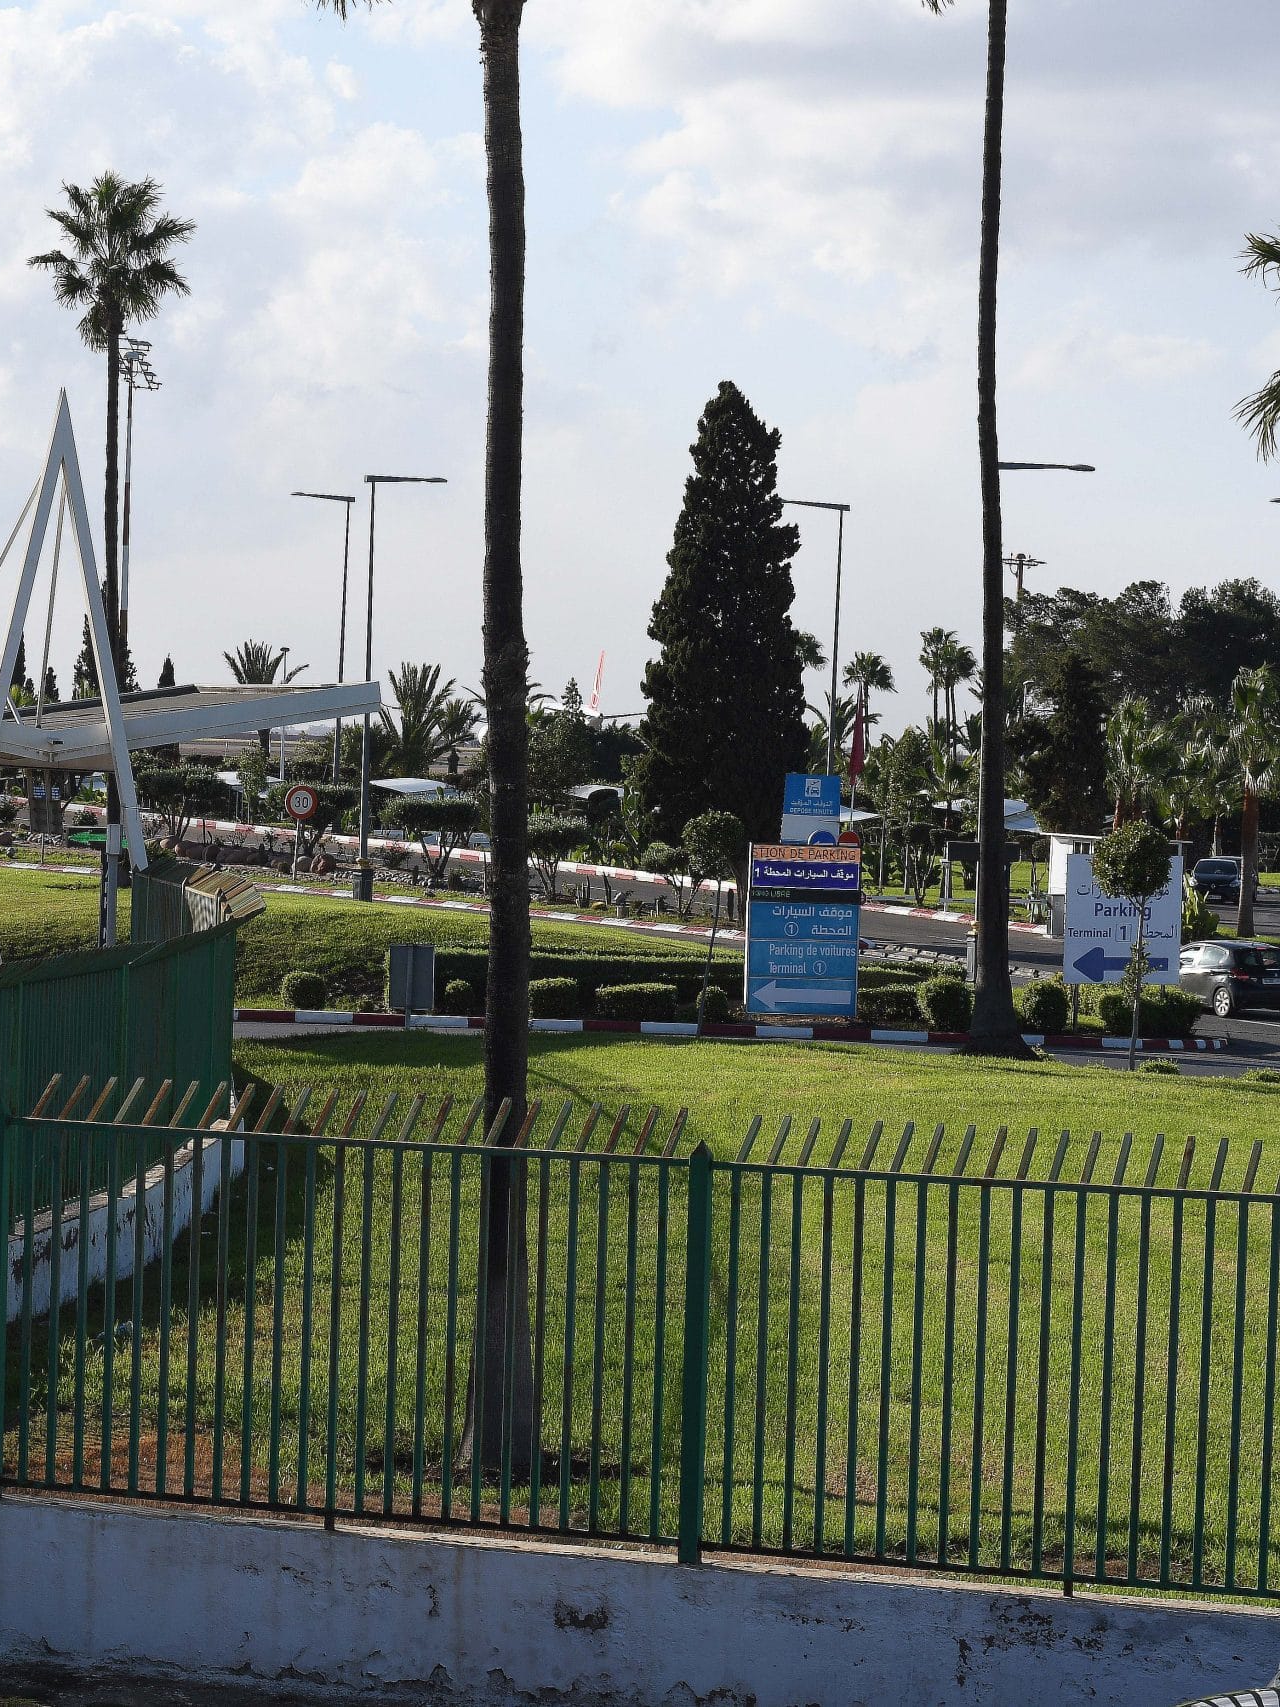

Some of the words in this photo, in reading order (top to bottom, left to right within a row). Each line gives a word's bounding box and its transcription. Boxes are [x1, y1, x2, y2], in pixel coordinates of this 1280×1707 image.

[295, 796, 309, 808] 30
[790, 848, 804, 858] DE
[808, 849, 856, 861] PARKING
[754, 867, 760, 877] 1
[763, 865, 792, 878] المحطة
[794, 867, 828, 880] السيارات
[830, 869, 854, 881] موقف
[772, 905, 815, 919] السيارات
[818, 906, 853, 920] موقف
[811, 924, 852, 936] المحطة
[1068, 927, 1111, 938] Terminal
[769, 943, 804, 958] Parking
[806, 944, 818, 956] de
[820, 945, 856, 957] voitures
[768, 961, 806, 974] Terminal
